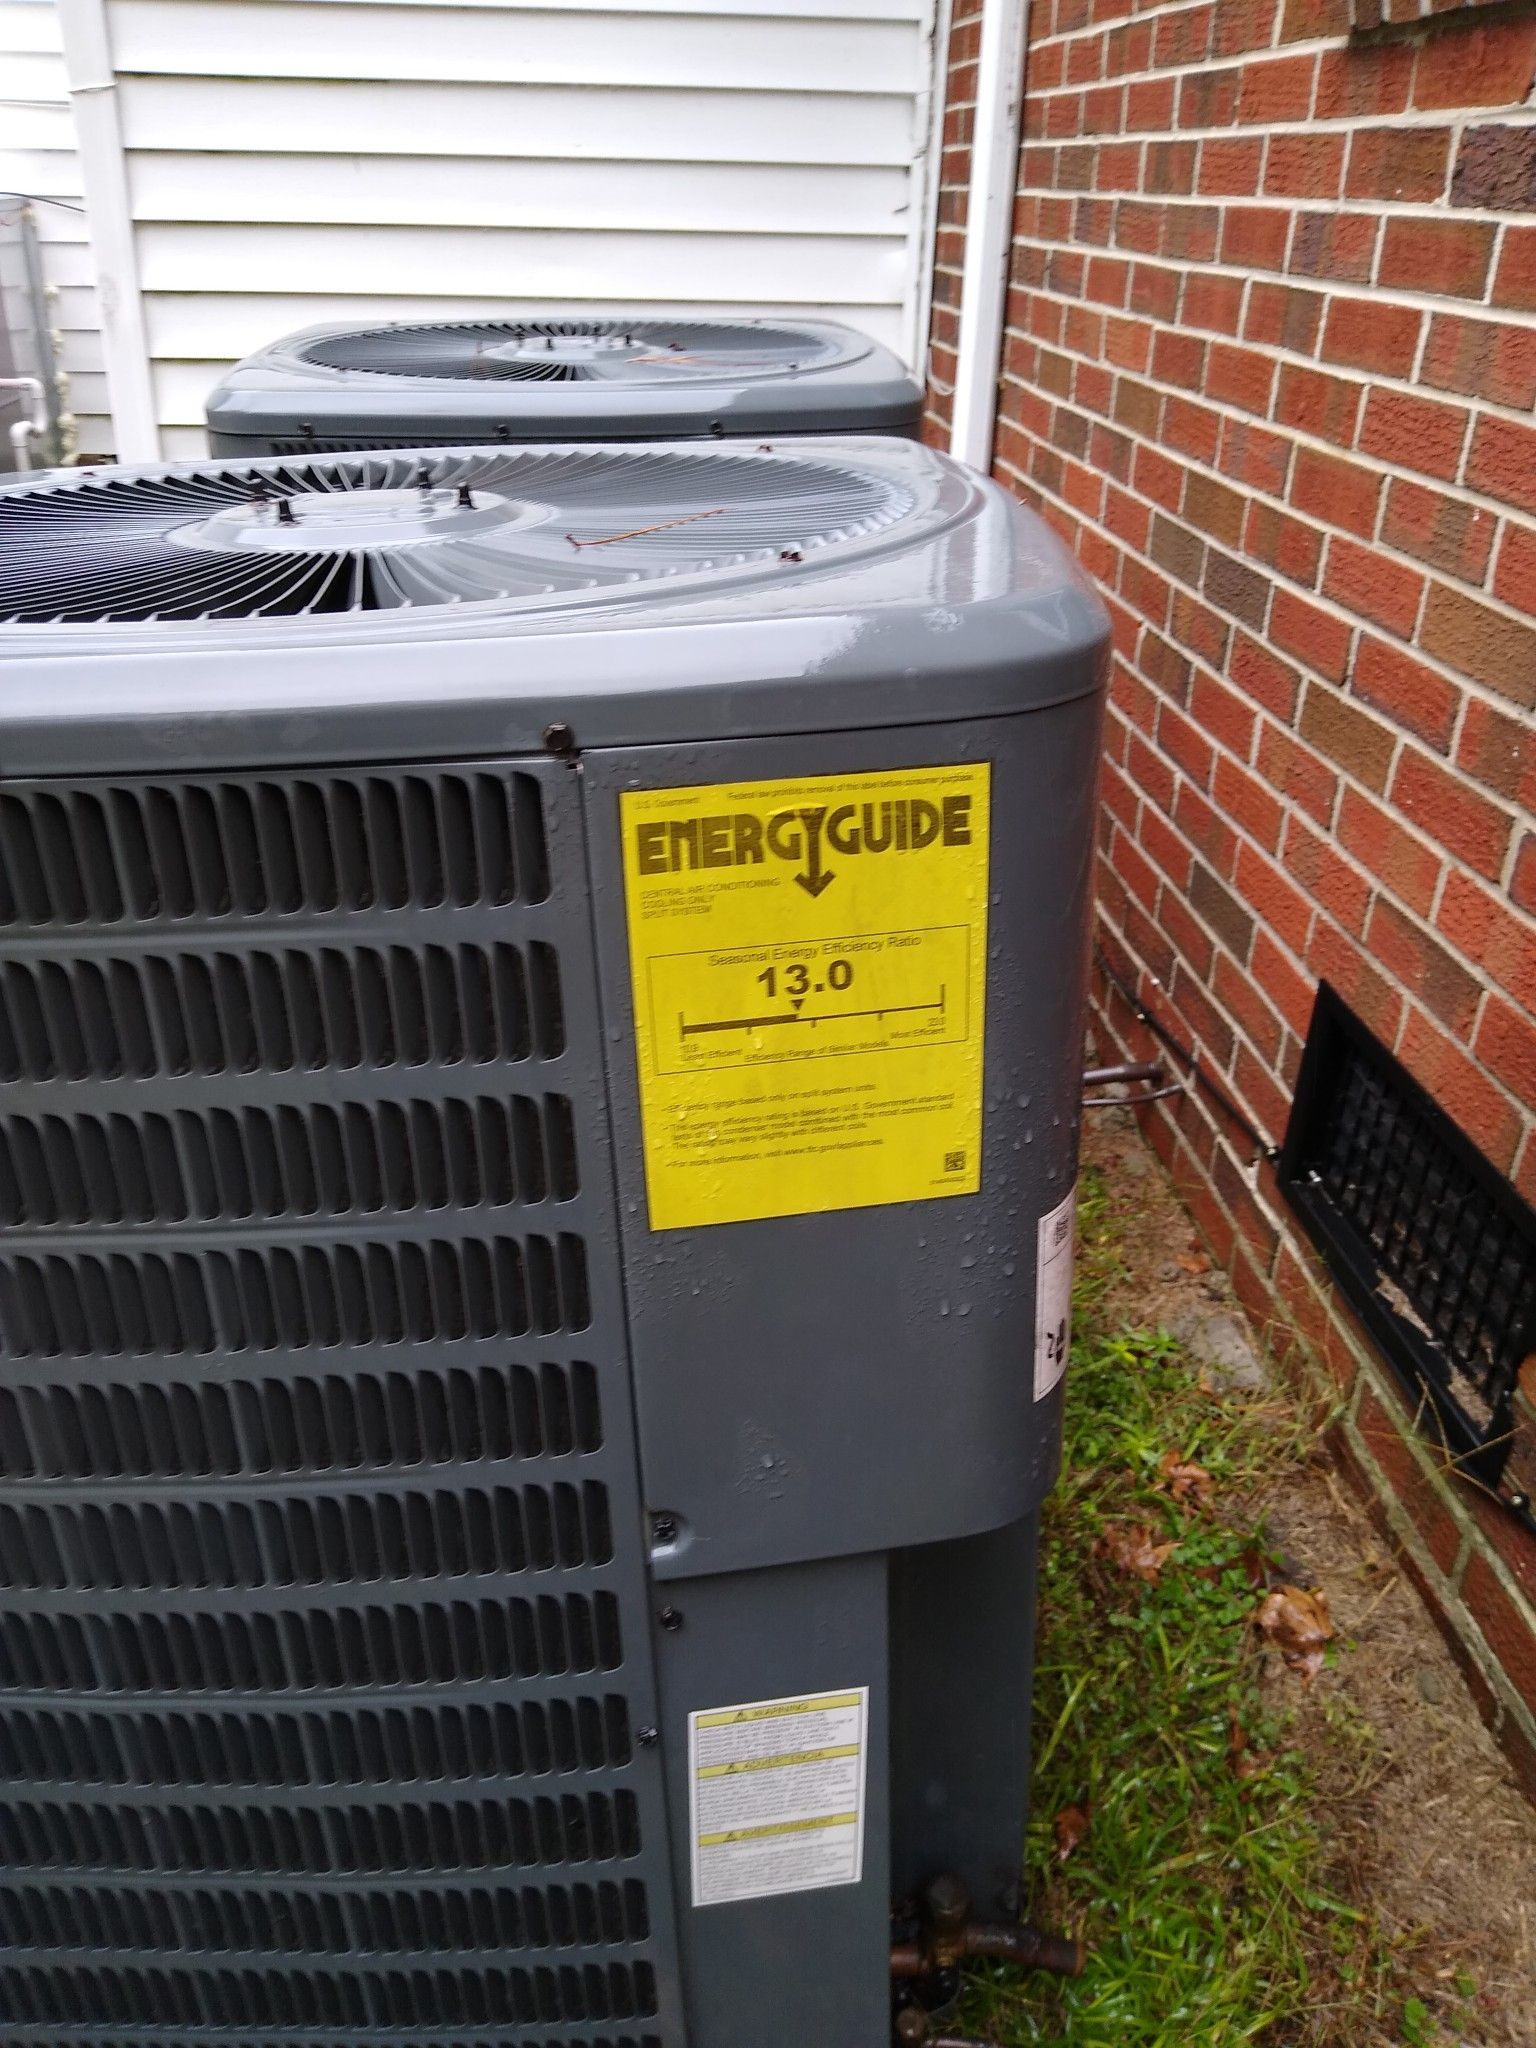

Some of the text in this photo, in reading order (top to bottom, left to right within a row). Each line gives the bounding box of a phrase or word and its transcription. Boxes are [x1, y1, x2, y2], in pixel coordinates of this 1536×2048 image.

[708, 935, 922, 967] Seasonal Energy Efficiency Ratio
[757, 959, 855, 998] 13.0
